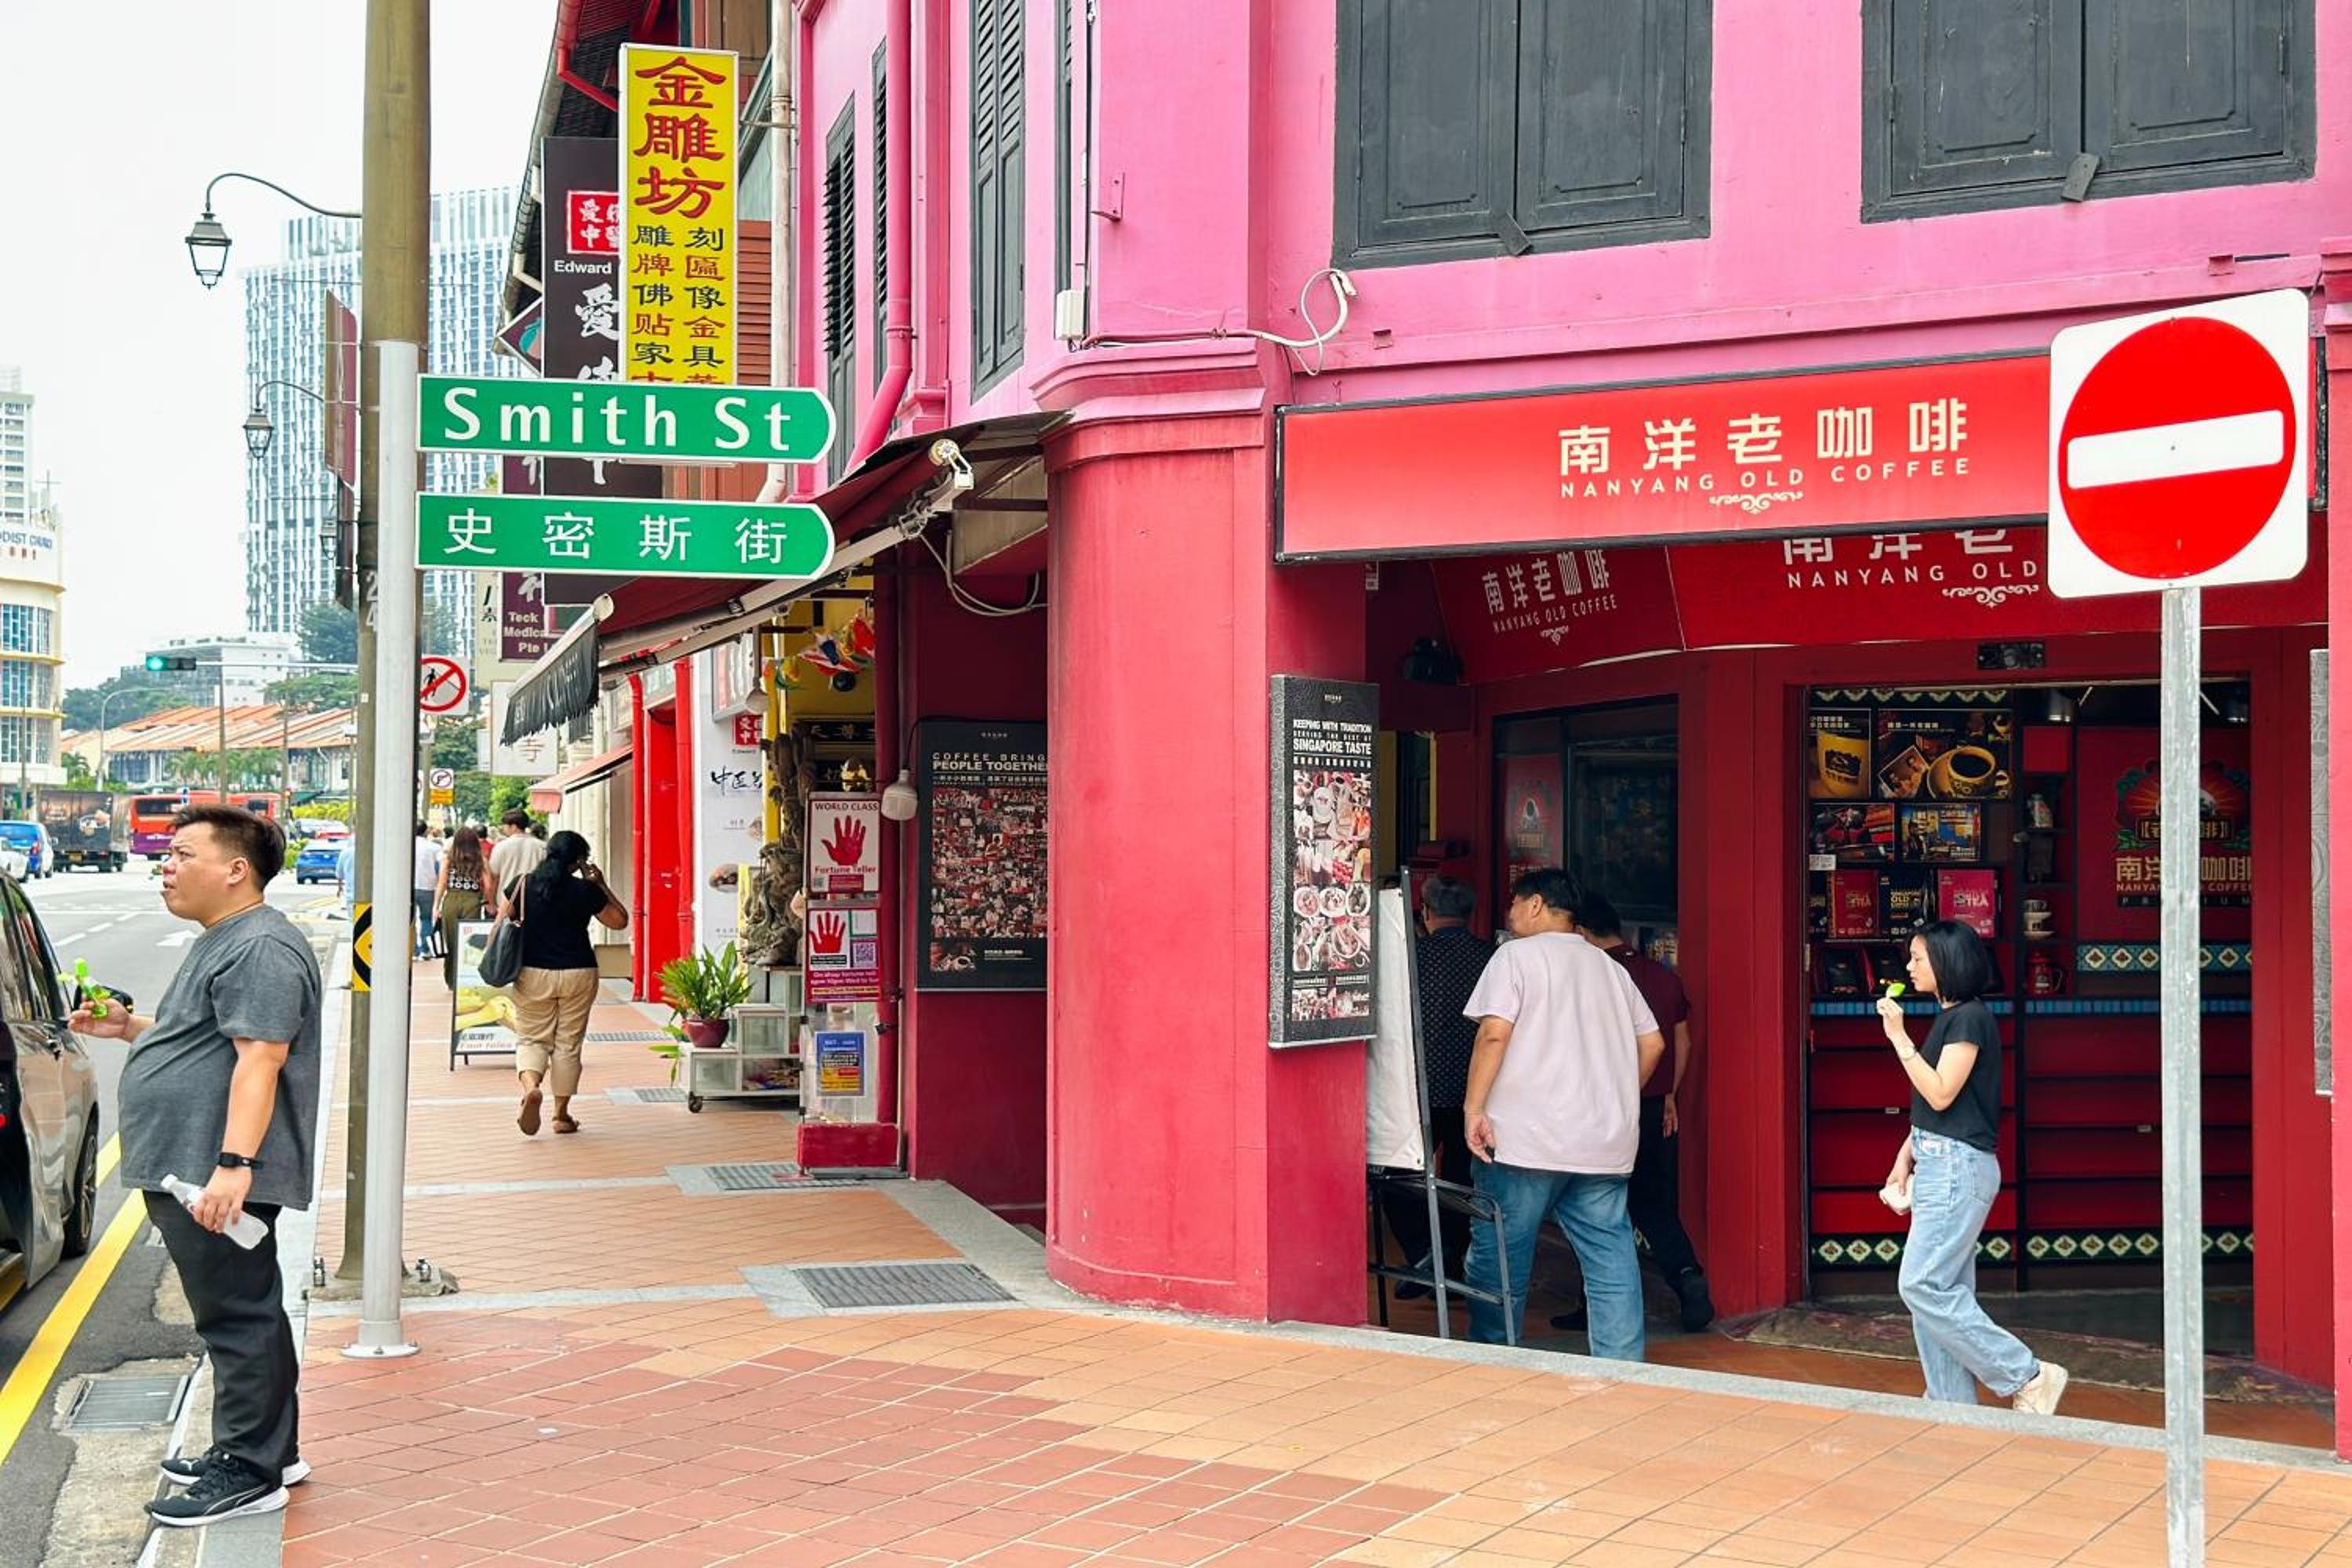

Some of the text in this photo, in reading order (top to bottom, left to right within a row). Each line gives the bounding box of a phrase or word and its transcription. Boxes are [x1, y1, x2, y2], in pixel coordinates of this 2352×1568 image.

[633, 56, 725, 219] 金雕坊
[632, 225, 724, 251] 雕刻
[554, 260, 612, 274] Edward
[632, 253, 724, 281] 牌匾
[632, 283, 725, 309] 佛像
[632, 313, 725, 339] 贴金
[632, 343, 724, 368] 家具
[444, 387, 791, 452] Smith St
[1559, 397, 1967, 476] 南洋老咖啡
[1560, 458, 1969, 499] NANYANG OLD COFFEE
[0, 531, 26, 544] DIST
[443, 508, 787, 564] 史密斯街
[1482, 549, 1610, 615] 南洋老咖啡
[1788, 561, 2037, 588] NANYANG OLD
[508, 612, 539, 622] Teck
[1493, 593, 1617, 633] NANYANG OLD COFFEE
[503, 626, 546, 638] Medica
[518, 643, 540, 653] Pte
[1322, 720, 1338, 731] WITH
[932, 753, 990, 761] COFFEE
[1293, 738, 1371, 754] SINGAPORE TASTE
[932, 760, 1047, 771] PEOPLE TOGETHE
[815, 802, 879, 811] WORLD CLASS
[815, 865, 877, 874] Fortune Teller
[2116, 882, 2161, 891] NANYA
